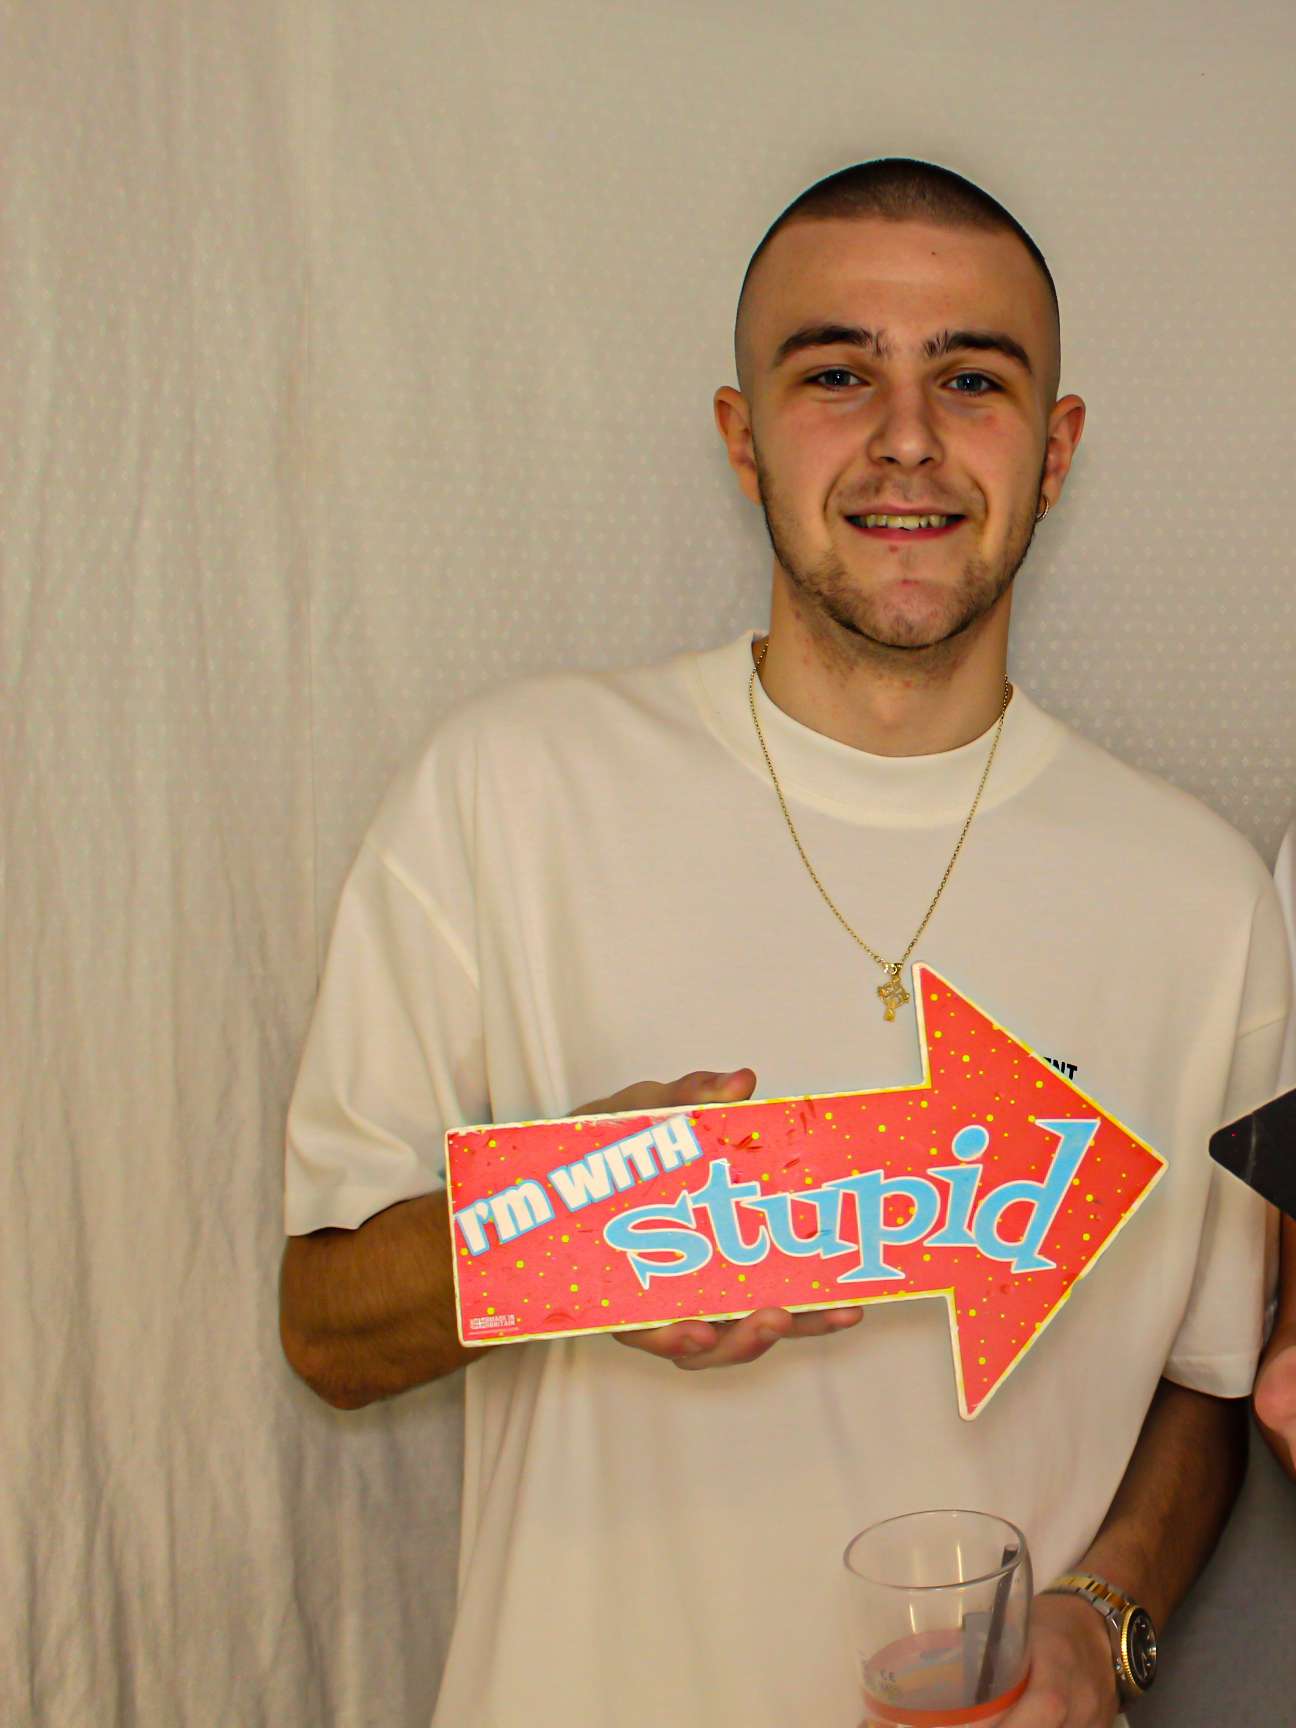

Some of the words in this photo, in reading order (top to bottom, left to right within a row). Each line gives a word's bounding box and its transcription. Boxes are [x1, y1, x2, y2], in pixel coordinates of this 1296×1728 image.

[1043, 1056, 1078, 1081] NT
[547, 1114, 703, 1212] WITH
[603, 1118, 1101, 1290] stupid
[489, 1320, 515, 1328] BRITAIN
